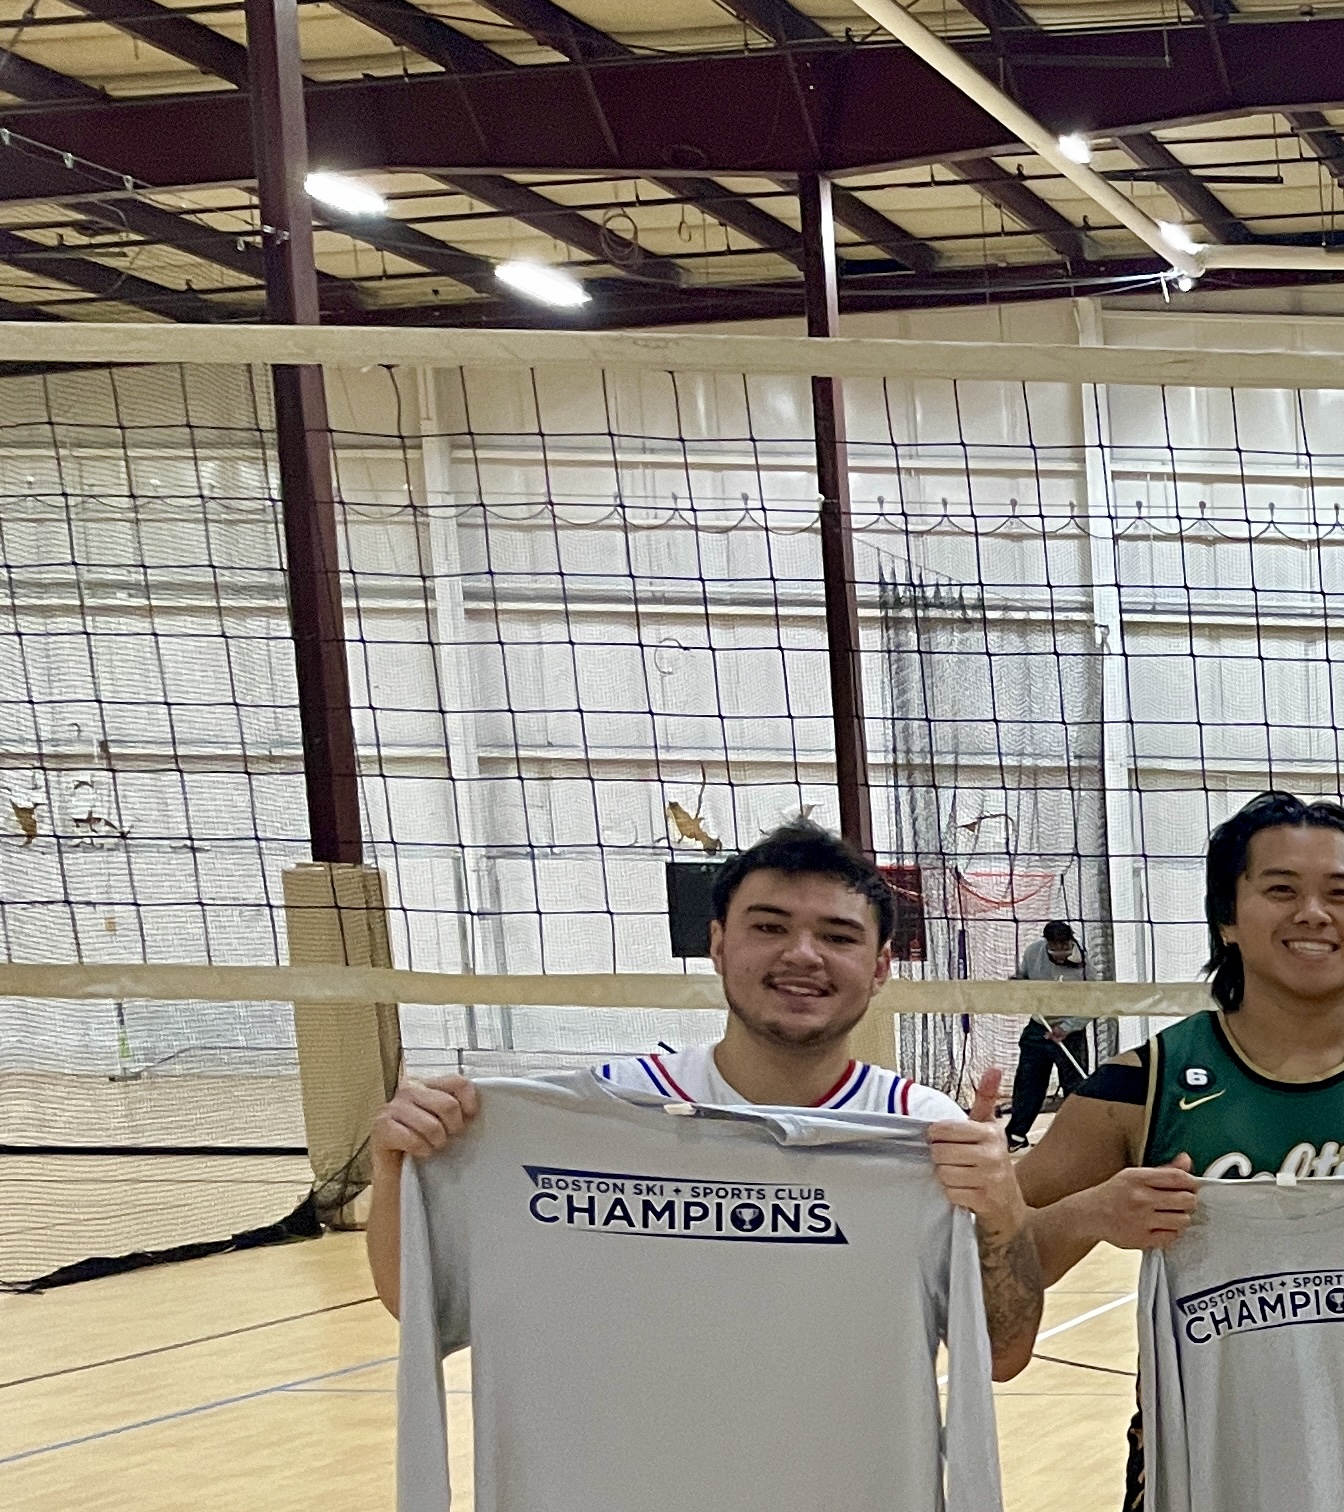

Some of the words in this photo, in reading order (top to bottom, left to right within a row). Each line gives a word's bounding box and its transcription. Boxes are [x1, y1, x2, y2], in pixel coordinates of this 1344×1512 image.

[1186, 1068, 1208, 1086] 6
[540, 1177, 625, 1195] BOSTON
[633, 1183, 664, 1197] SKI
[690, 1186, 766, 1200] SPORTS
[775, 1188, 825, 1200] CLUB
[529, 1192, 832, 1234] CHAMPIONS
[1188, 1286, 1247, 1314] BOSTON
[1249, 1281, 1274, 1295] SKI
